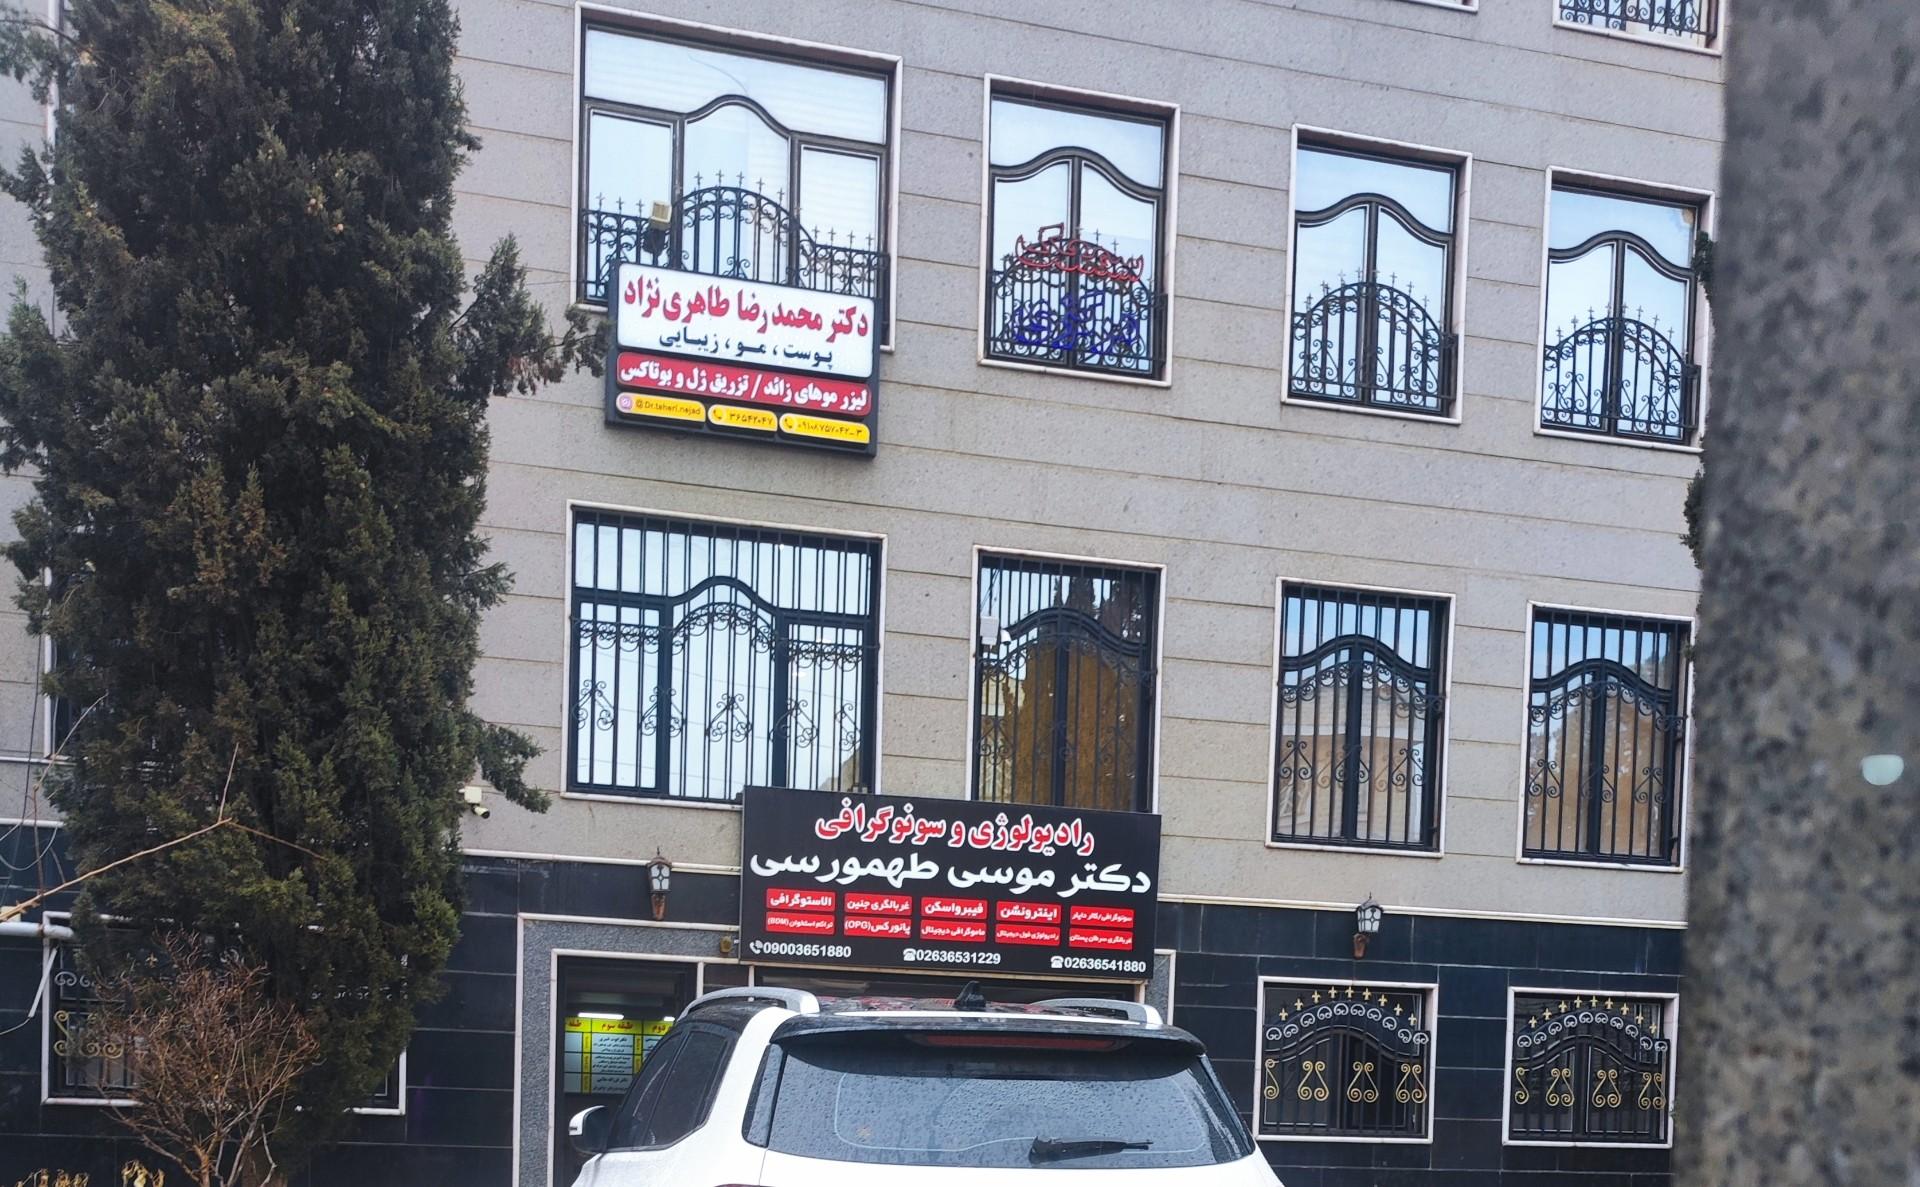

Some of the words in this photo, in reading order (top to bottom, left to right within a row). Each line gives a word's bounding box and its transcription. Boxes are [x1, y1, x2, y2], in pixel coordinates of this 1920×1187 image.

[826, 306, 868, 343] دکتر
[660, 326, 719, 353] زیبایی
[620, 360, 672, 387] بوتاکس
[674, 372, 684, 388] و
[686, 366, 707, 392] ژل
[709, 373, 749, 396] تزریق
[764, 377, 792, 403] زائد
[794, 383, 838, 407] موهای
[840, 389, 867, 411] لیزر
[815, 797, 947, 845] سونوگرافی
[948, 820, 966, 847] و
[968, 812, 1095, 856] رادیولوژی
[750, 852, 940, 889] طهمورسی
[947, 865, 1055, 895] موسی
[1057, 862, 1151, 898] دکتر
[770, 892, 832, 908] الاستوگرافی
[847, 899, 870, 910] جنین
[871, 898, 910, 912] غربالگری
[1000, 905, 1058, 920] اینترونشن
[763, 942, 852, 958] 09003651880
[916, 949, 1001, 965] 02636531229
[1064, 957, 1147, 973] 02636541880
